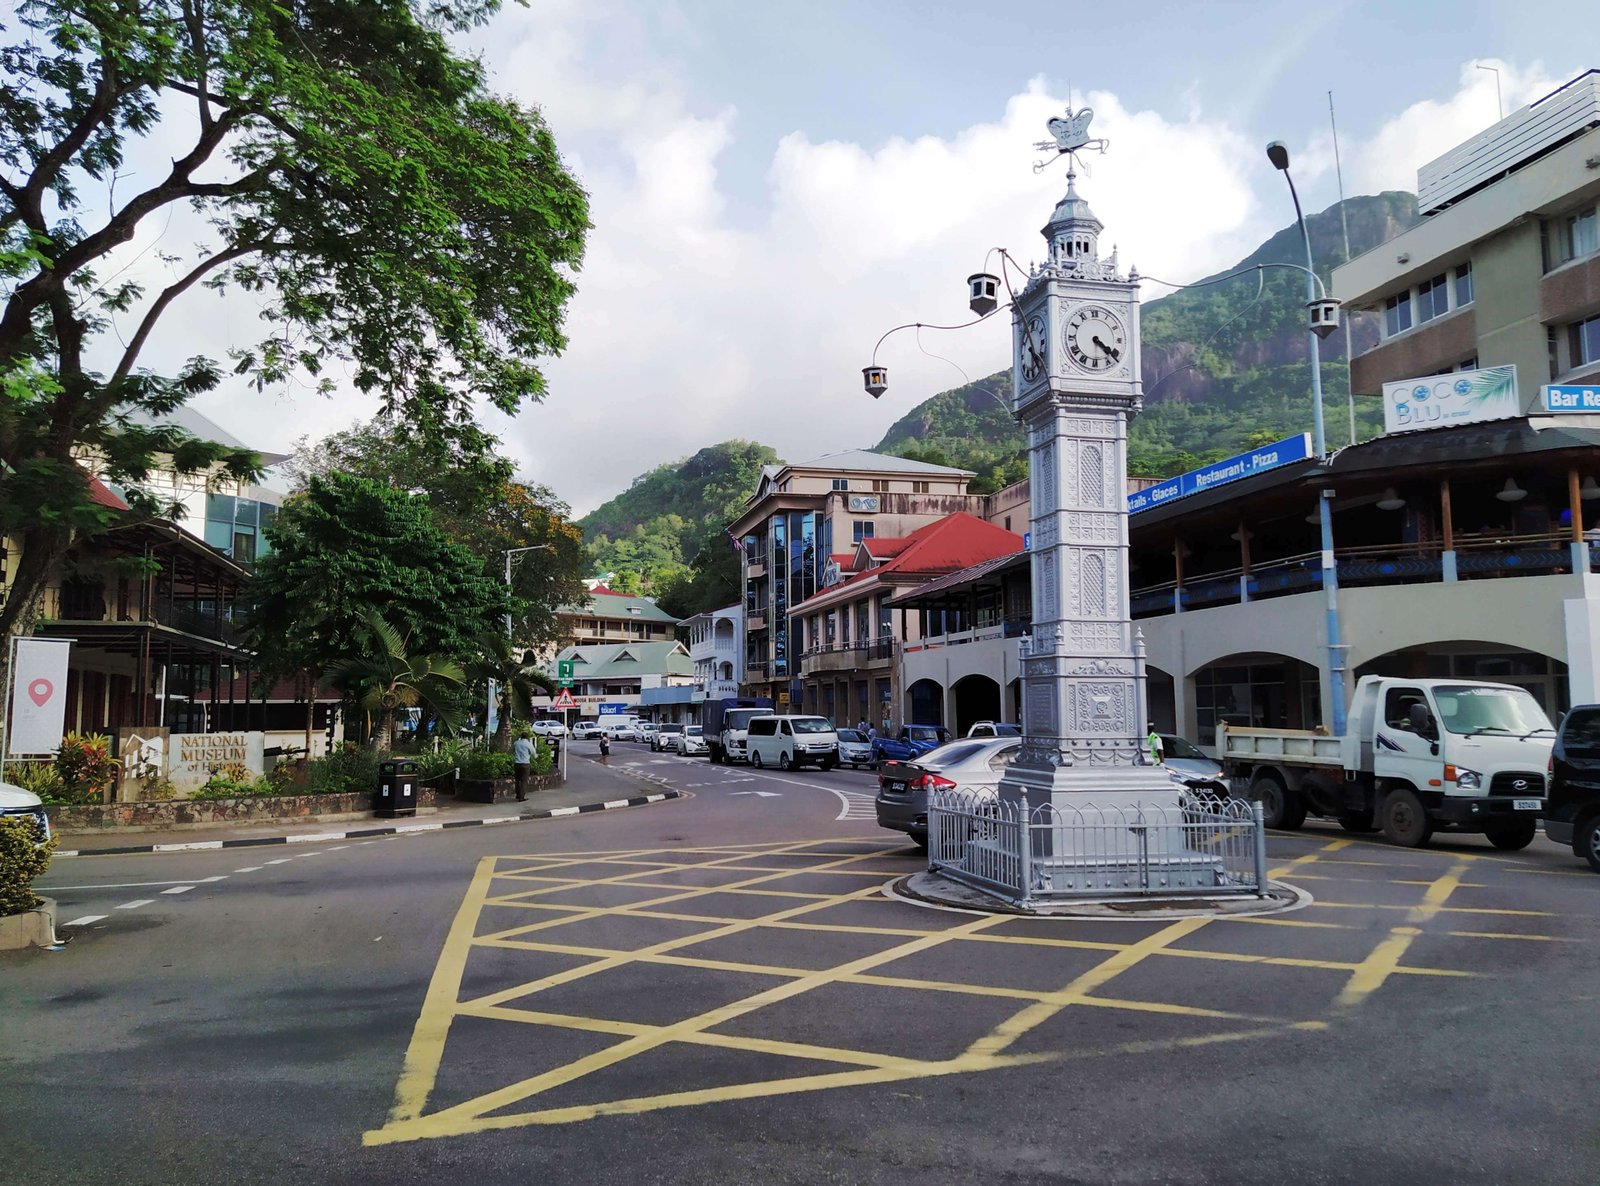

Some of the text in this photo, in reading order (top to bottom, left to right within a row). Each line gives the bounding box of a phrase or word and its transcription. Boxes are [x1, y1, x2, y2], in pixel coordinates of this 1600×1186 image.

[1391, 379, 1473, 405] COCO
[1550, 389, 1580, 407] Bar
[1394, 403, 1441, 425] BLU
[1196, 459, 1245, 487] Restaurant
[1252, 450, 1278, 470] Pizza
[1151, 484, 1178, 502] Glaces
[180, 735, 248, 748] NATIONAL
[180, 748, 247, 761] MUSEUM
[187, 761, 199, 772] of
